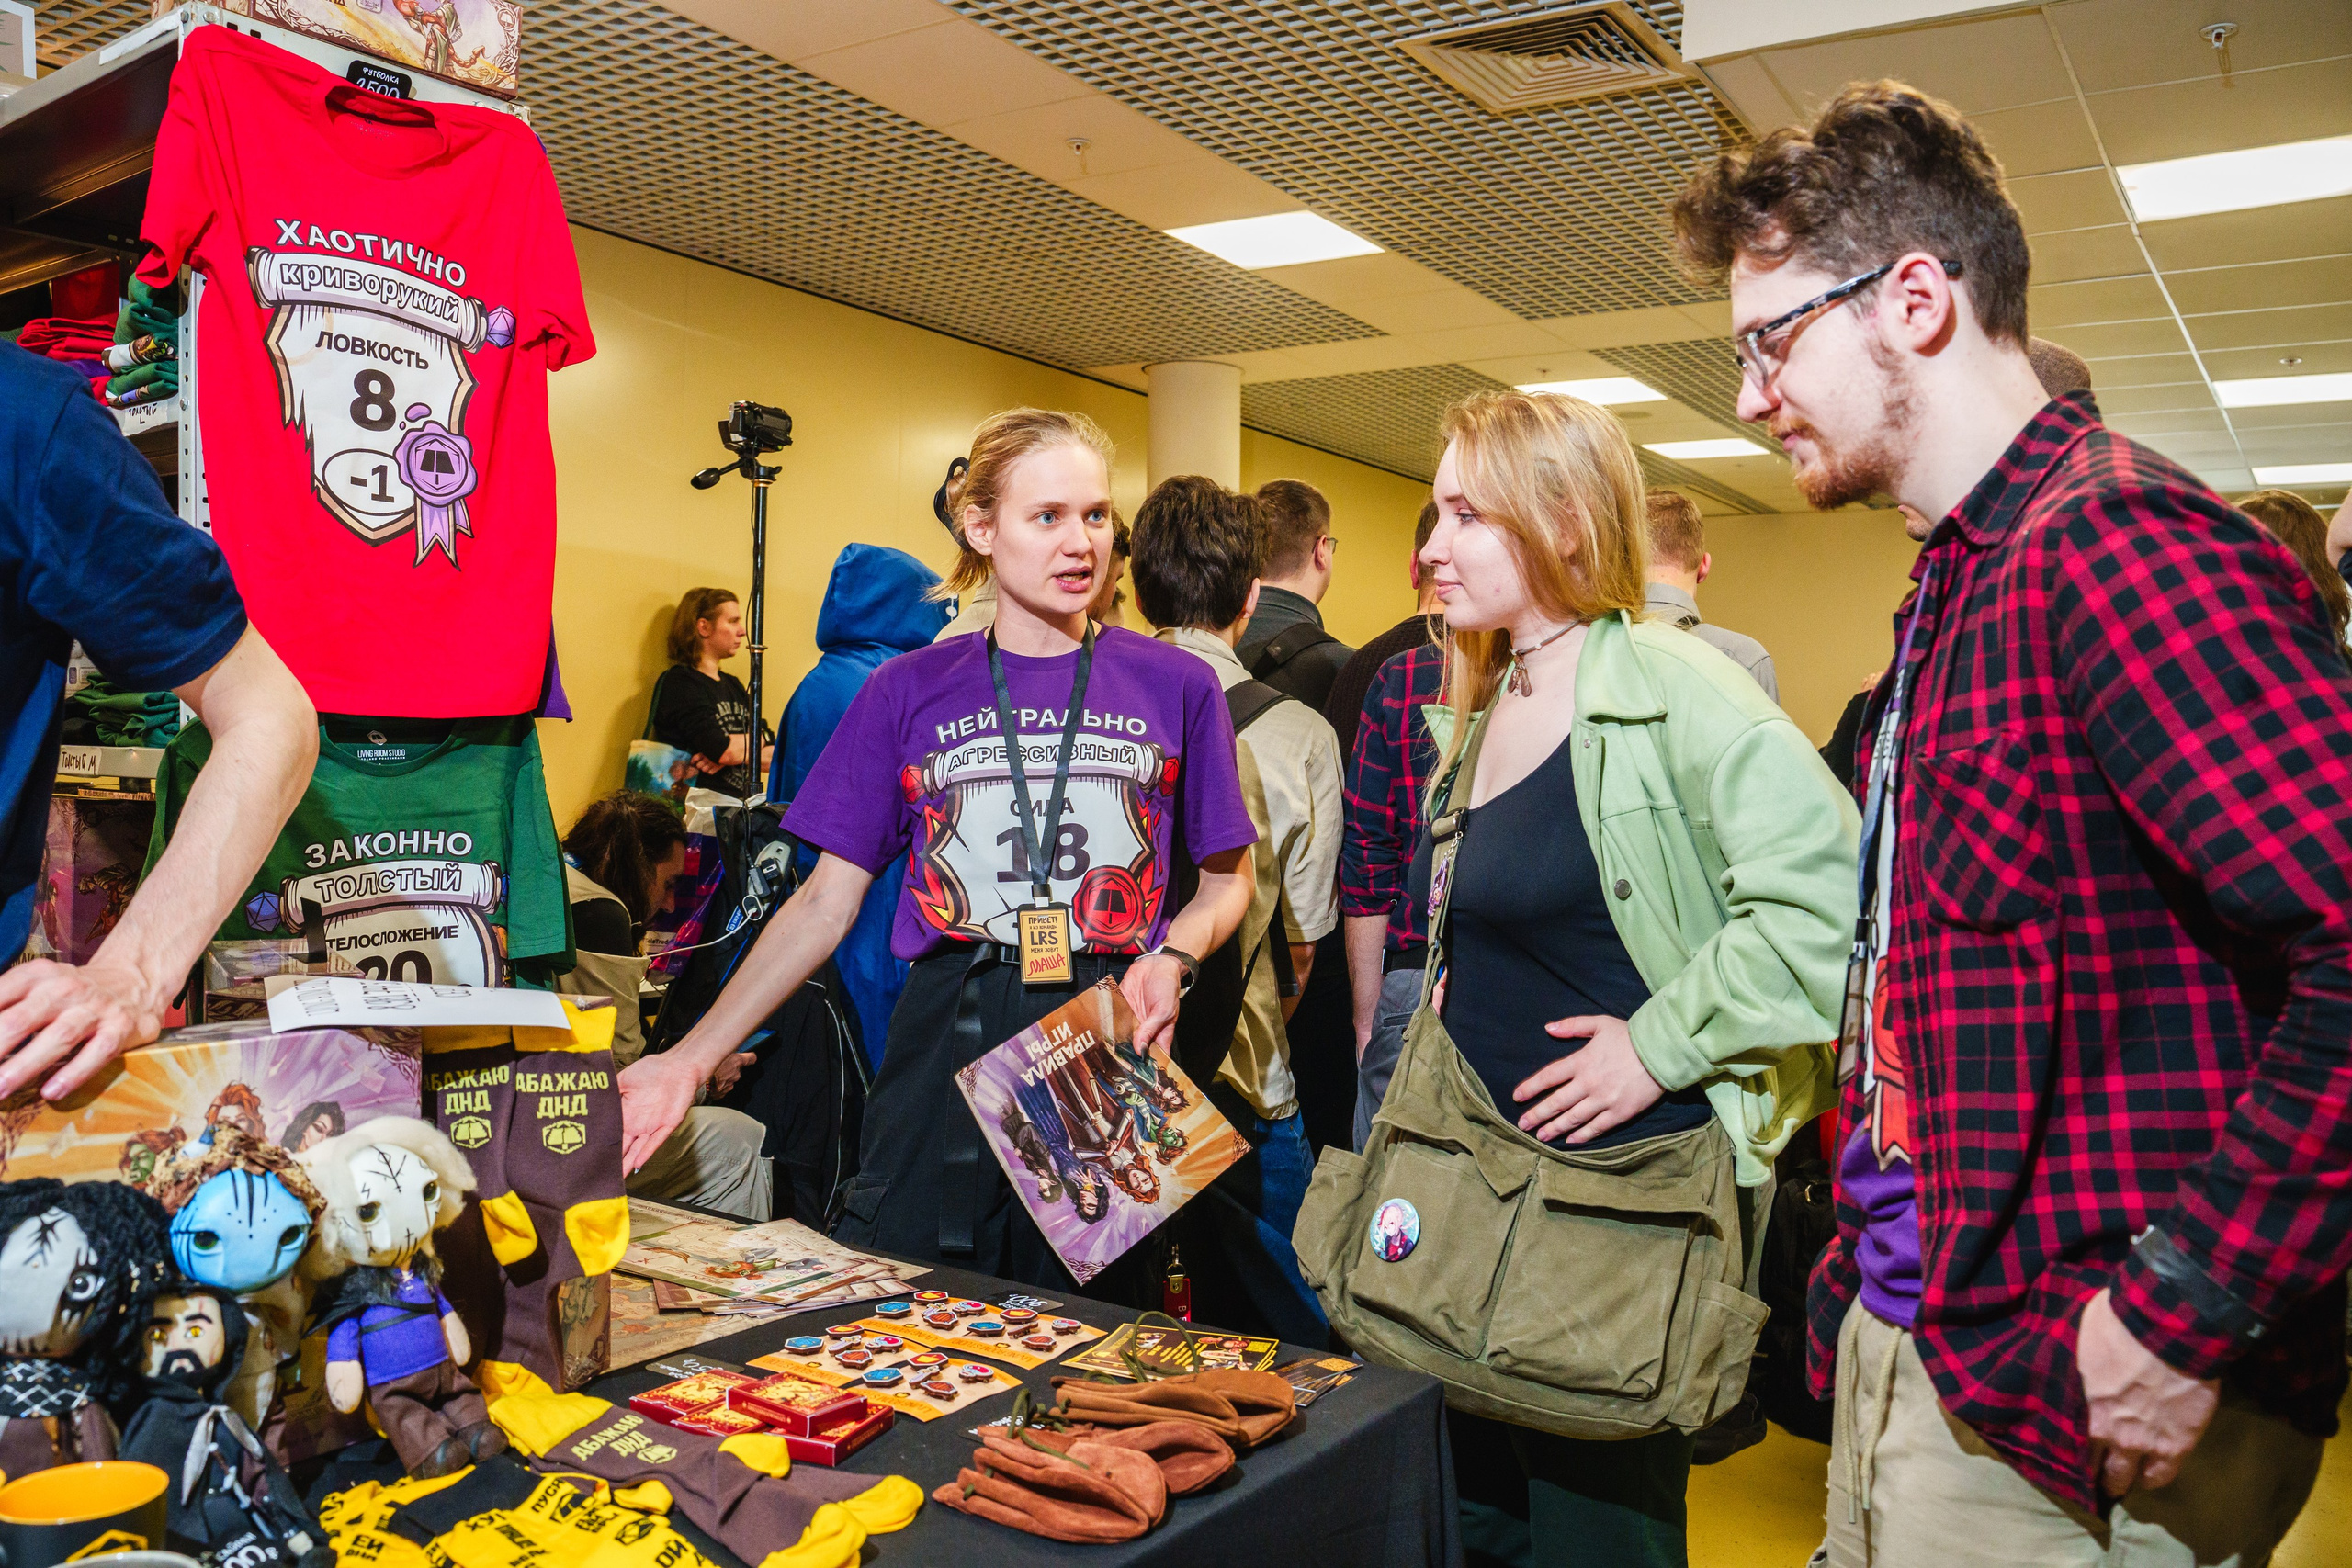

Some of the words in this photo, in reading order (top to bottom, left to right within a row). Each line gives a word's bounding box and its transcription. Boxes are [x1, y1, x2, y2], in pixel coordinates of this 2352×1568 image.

[362, 66, 400, 85] ФУТБОЛКА
[274, 218, 467, 288] ХАОТИЧНО
[279, 263, 461, 323] криворукий
[315, 330, 430, 370] ЛОВКОСТЬ
[349, 368, 397, 432] 8
[350, 464, 395, 503] -1
[935, 706, 1148, 745] НЕЙРАЬНО
[357, 750, 373, 758] LIVING
[374, 749, 388, 757] ROOM
[389, 748, 406, 757] STUDIO
[304, 829, 474, 869] ЗАКОННО
[996, 822, 1091, 883] 18
[314, 863, 462, 903] ТОЛСТЫЙ
[325, 925, 459, 951] ТЕЛОСЛОЖЕНИЕ
[1029, 916, 1057, 925] ПРИВЕТ!
[1030, 931, 1058, 946] LRS
[1027, 953, 1066, 976] МАША
[1020, 1030, 1096, 1087] ПРАВИЛА
[1025, 1021, 1073, 1062] ИГРЫ
[445, 1089, 492, 1116] ДНД
[537, 1093, 588, 1120] ДНД
[609, 1430, 653, 1458] ДНД
